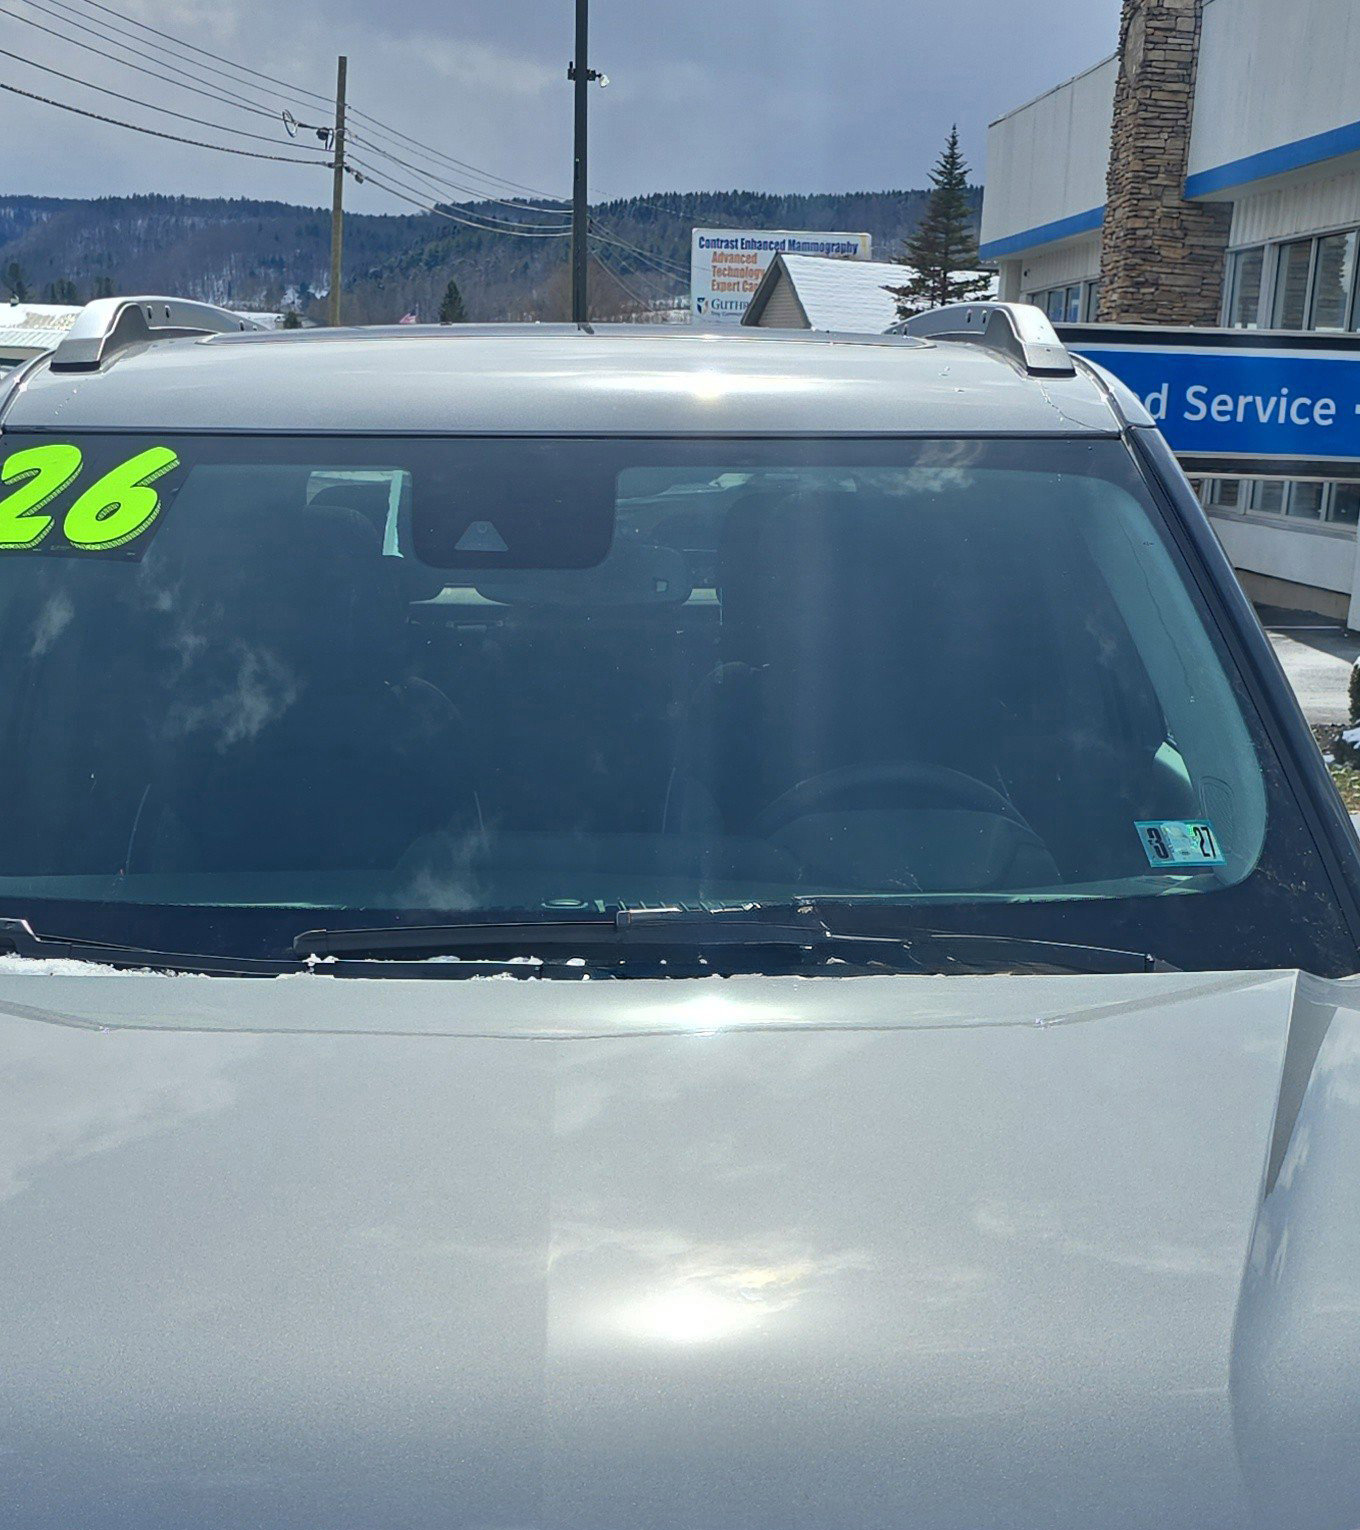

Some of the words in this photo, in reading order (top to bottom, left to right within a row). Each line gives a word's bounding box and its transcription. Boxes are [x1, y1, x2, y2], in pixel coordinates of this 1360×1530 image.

[698, 236, 739, 250] Contrast
[740, 237, 786, 252] Enhanced
[787, 239, 859, 256] Mammography
[711, 251, 758, 265] Advanced
[711, 279, 740, 292] Expert
[1183, 385, 1336, 426] Service
[1147, 827, 1170, 859] 3
[1192, 826, 1217, 860] 27
